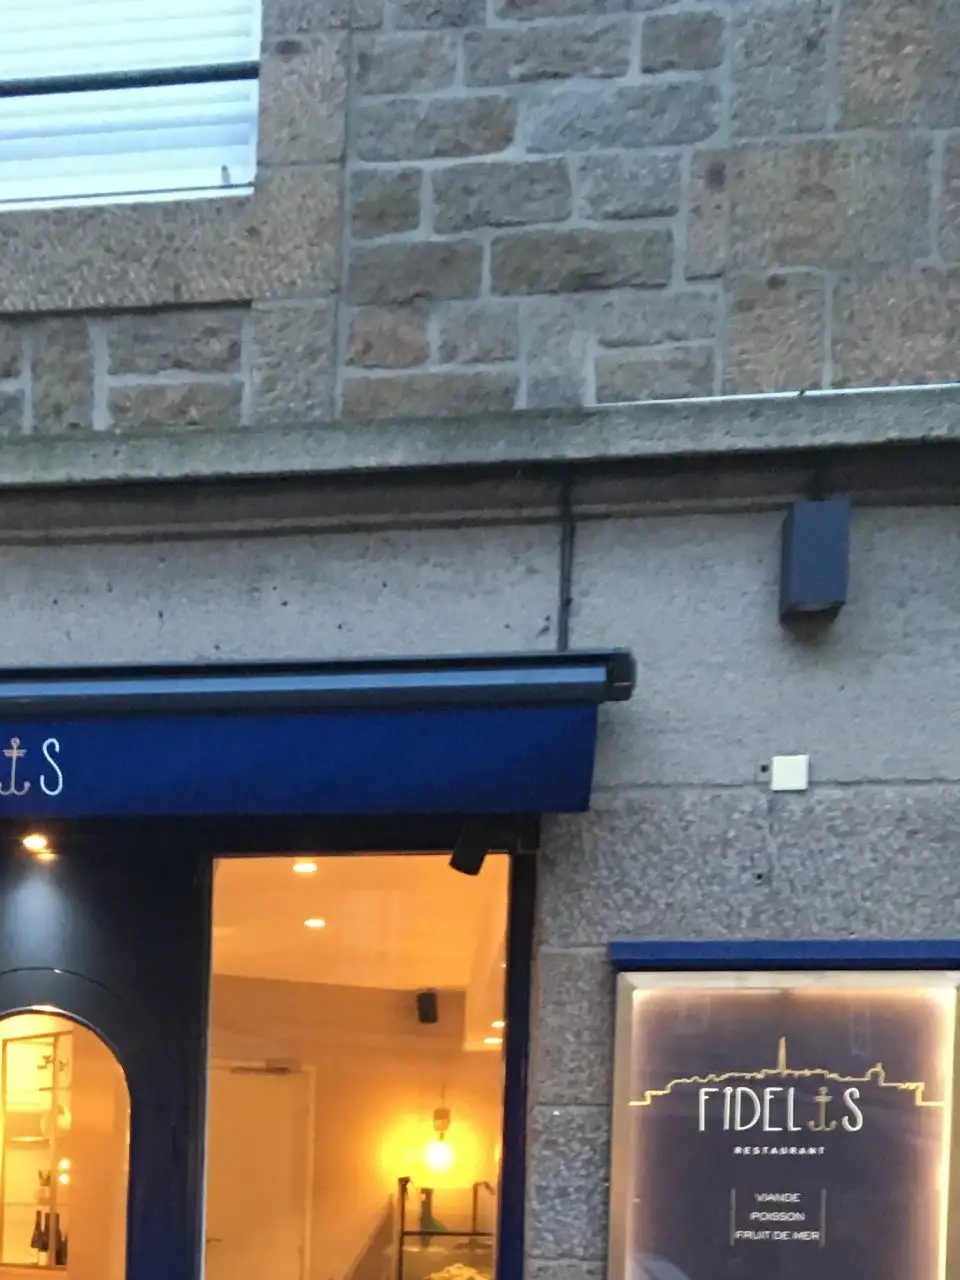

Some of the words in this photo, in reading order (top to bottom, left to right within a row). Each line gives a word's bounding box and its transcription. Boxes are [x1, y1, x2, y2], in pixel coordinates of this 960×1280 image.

[733, 1146, 826, 1156] RESTAURANT
[754, 1192, 801, 1203] VIANDE
[749, 1211, 806, 1221] POISSON
[735, 1230, 771, 1241] FRUIT
[773, 1230, 791, 1241] DE
[792, 1230, 820, 1241] MER
